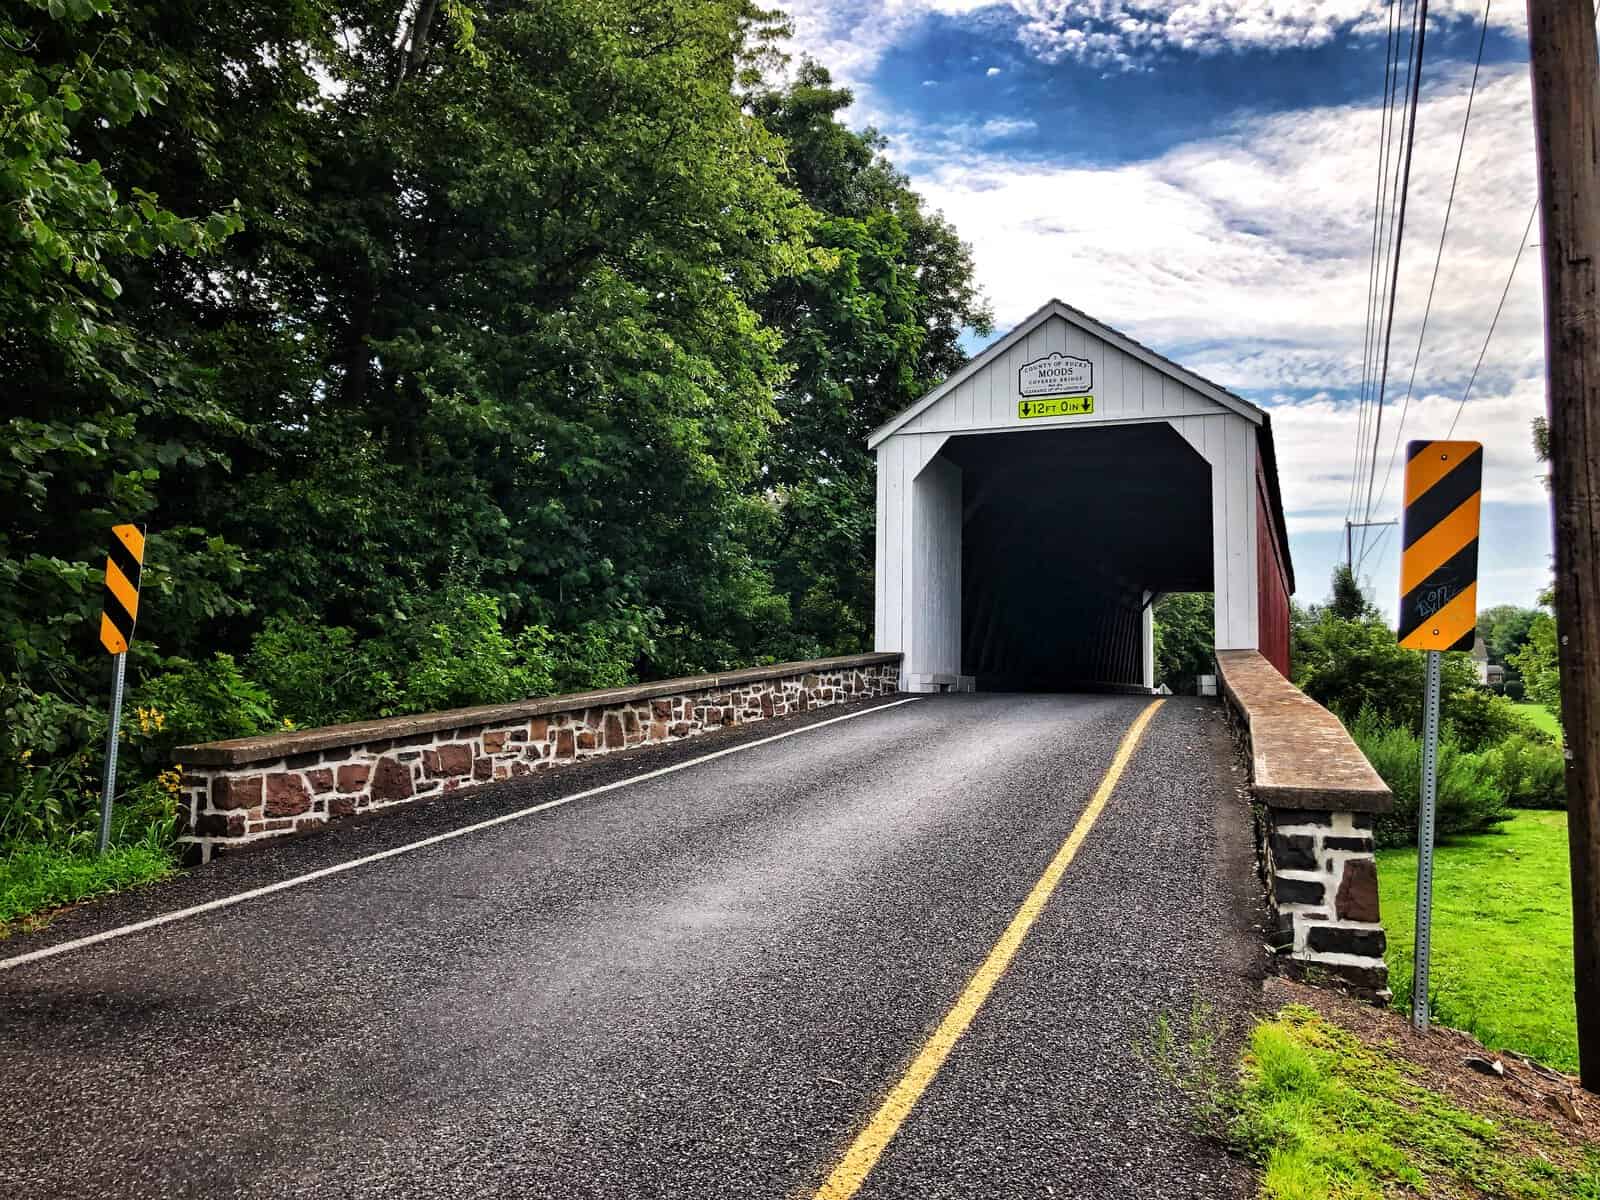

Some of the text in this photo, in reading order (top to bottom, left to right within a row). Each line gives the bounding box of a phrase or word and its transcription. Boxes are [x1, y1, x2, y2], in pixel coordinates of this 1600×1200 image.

[1024, 363, 1052, 373] COUNTY
[1038, 367, 1073, 378] MOODS
[1033, 400, 1079, 414] 12FT 0IN
